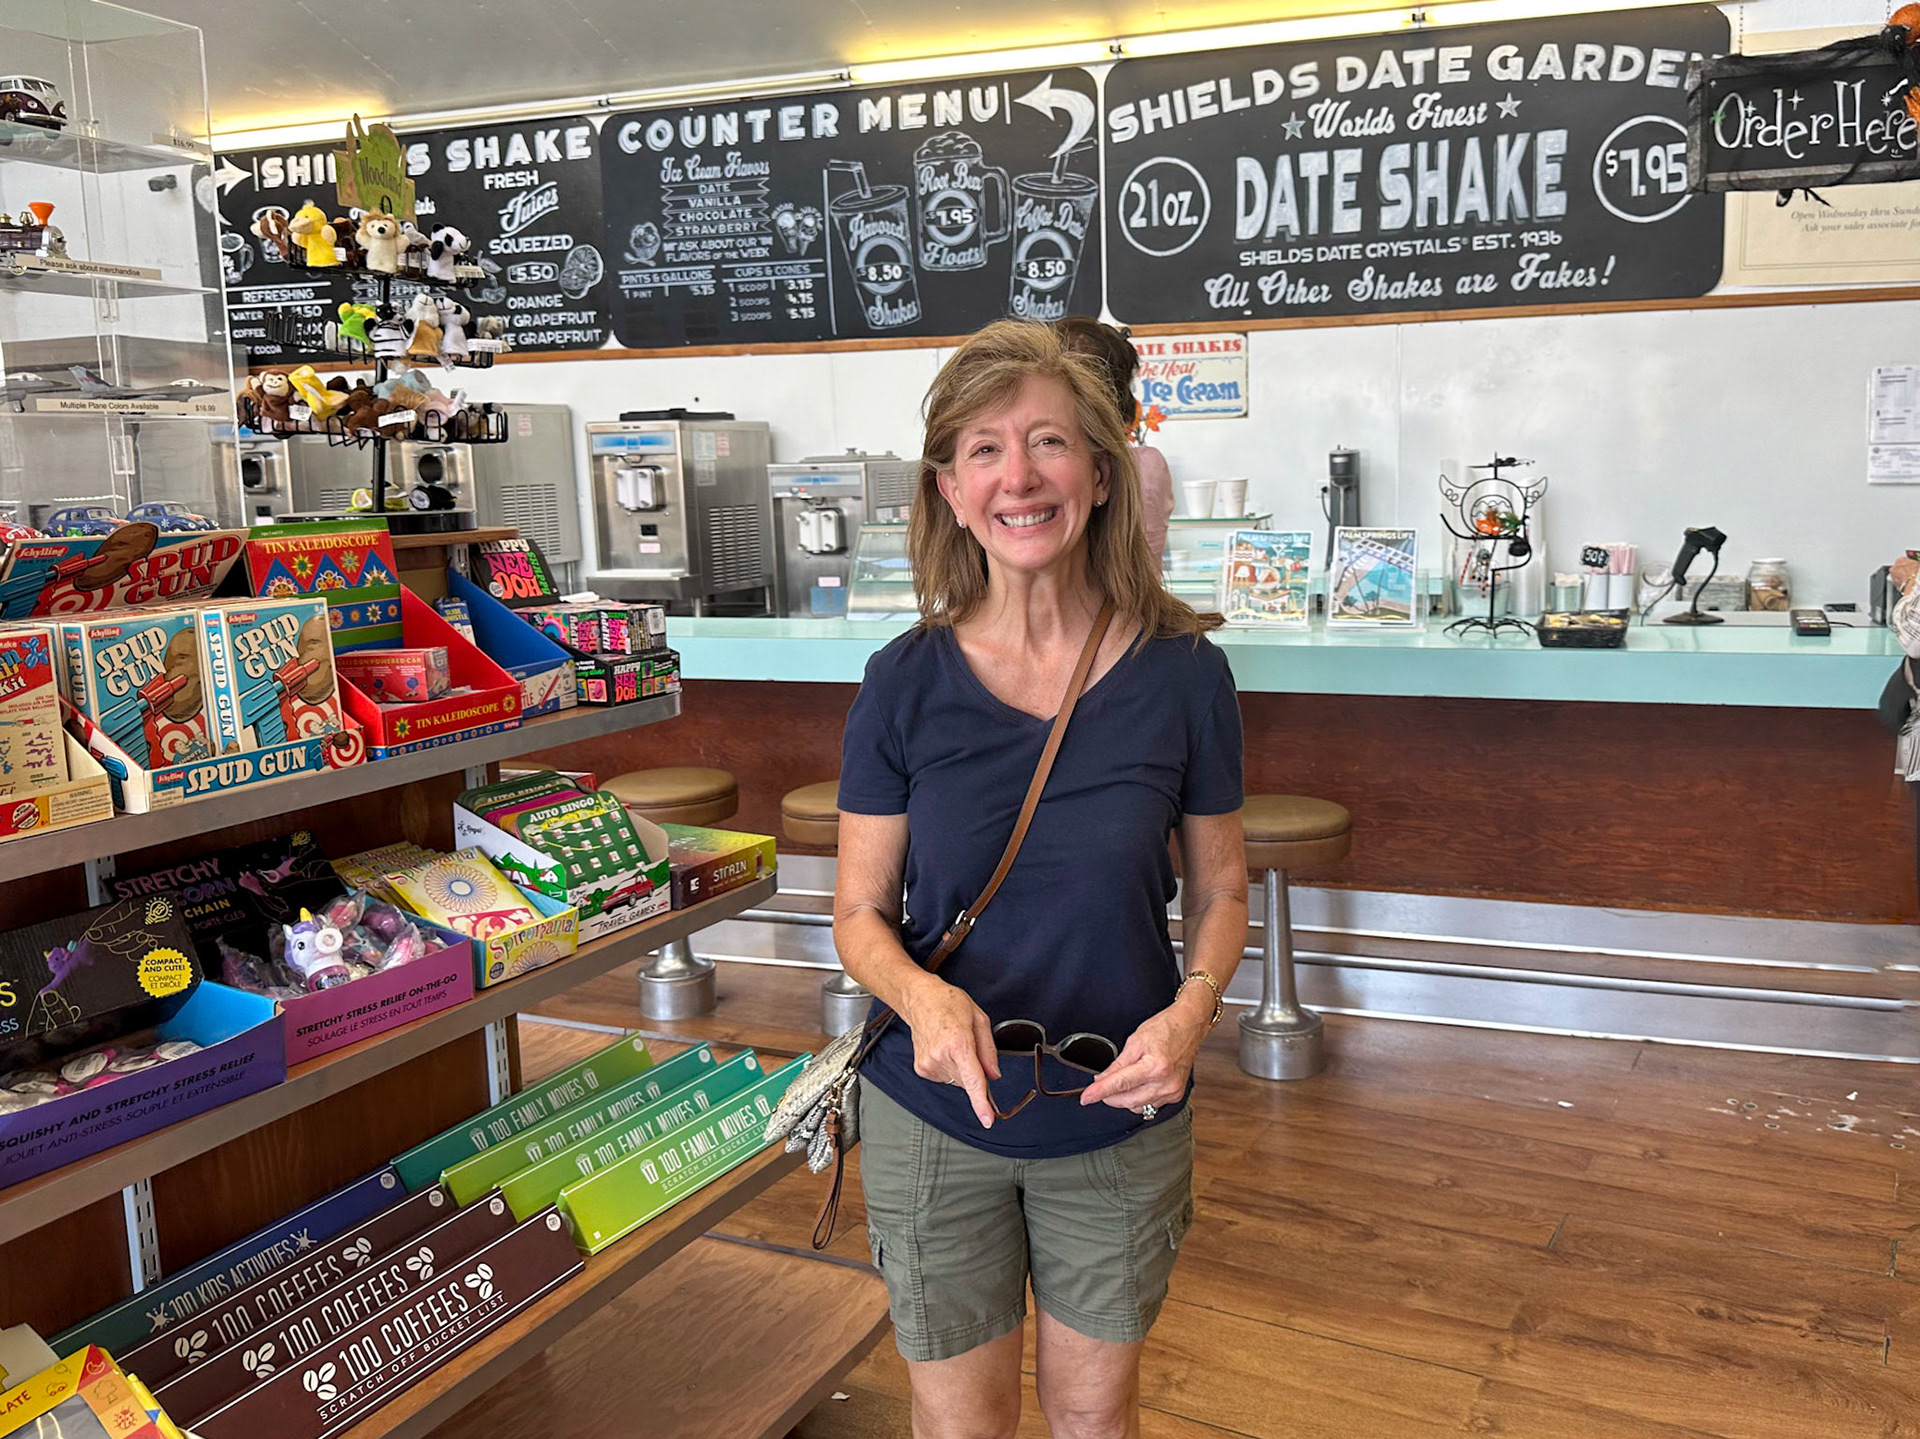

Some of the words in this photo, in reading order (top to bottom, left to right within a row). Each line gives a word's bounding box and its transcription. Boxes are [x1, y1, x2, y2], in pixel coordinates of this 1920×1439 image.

[1108, 61, 1321, 144] SHIELDS
[1336, 45, 1473, 93] DATE
[617, 103, 840, 154] COUNTER
[858, 86, 999, 133] MENU
[1307, 98, 1396, 139] Worlds
[1406, 91, 1488, 130] Finest
[1714, 89, 1834, 159] Order
[1833, 79, 1917, 154] Here
[446, 126, 592, 172] SHAKE
[483, 169, 539, 190] FRESH
[661, 157, 684, 182] Ice
[685, 154, 723, 181] Cream
[724, 151, 770, 178] Flavors
[919, 166, 951, 196] Root
[951, 161, 983, 191] Beer
[1605, 142, 1687, 196] $7.95
[699, 183, 731, 194] DATE
[1235, 148, 1363, 241] DATE
[1379, 128, 1569, 232] SHAKE
[501, 187, 559, 232] Juices
[688, 195, 742, 208] VANILLA
[675, 222, 759, 236] STRAWBERRY
[678, 208, 753, 223] CHOCOLATE
[1017, 198, 1053, 231] Coffee
[1054, 202, 1085, 240] Date
[488, 234, 574, 254] SQUEEZED
[678, 240, 700, 251] ASK
[700, 239, 735, 250] ABOUT
[736, 237, 757, 248] OUR
[848, 213, 907, 251] Flavored
[666, 251, 711, 262] FLAVORS
[724, 251, 739, 259] THE
[740, 247, 770, 258] WEEK
[923, 241, 982, 266] Floats
[1239, 247, 1314, 267] SHIELDS
[1316, 244, 1363, 263] DATE
[1472, 233, 1517, 251] EST.
[1519, 230, 1563, 247] 1936
[40, 258, 64, 269] Please
[65, 262, 78, 271] ask
[79, 263, 99, 272] about
[99, 265, 141, 276] merchandise
[621, 273, 651, 285] PINTS
[661, 270, 713, 282] GALLONS
[734, 266, 764, 278] CUPS
[775, 264, 811, 276] CONES
[1204, 272, 1250, 309] All
[1258, 269, 1333, 305] Other
[1347, 266, 1443, 302] Shakes
[1455, 272, 1498, 296] are
[1510, 252, 1616, 292] Fakes!
[242, 288, 315, 303] REFRESHING
[506, 294, 564, 309] ORANGE
[633, 289, 653, 299] PINT
[737, 283, 769, 293] SCOOP
[1013, 285, 1065, 318] Shakes
[231, 310, 264, 321] WATER
[738, 297, 771, 307] SCOOPS
[868, 295, 918, 325] Shakes
[512, 310, 597, 327] GRAPEFRUIT
[740, 311, 773, 321] SCOOPS
[232, 327, 267, 338] COFFEE
[518, 329, 602, 345] GRAPEFRUIT
[254, 345, 282, 355] COCOA
[1135, 343, 1165, 356] ATE
[1172, 341, 1243, 355] SHAKES
[1141, 378, 1173, 403] Ice
[1176, 375, 1241, 405] Cream
[60, 401, 87, 411] Multiple
[88, 402, 107, 410] Plane
[108, 402, 129, 410] Colors
[130, 402, 159, 411] Available
[19, 546, 65, 559] Schylling
[263, 541, 284, 554] TIN
[287, 534, 379, 552] KALEIDOSCOPE
[479, 539, 530, 553] HAPPY
[120, 534, 241, 588] SPUD
[483, 552, 534, 579] NEE
[124, 562, 221, 604] GUN
[493, 571, 543, 600] DOH
[95, 626, 168, 677] SPUD
[208, 631, 227, 689] SPUD
[105, 650, 167, 697] GUN
[217, 693, 236, 739] GUN
[415, 716, 432, 729] TIN
[433, 702, 500, 727] KALEIDOSCOPE
[186, 758, 254, 794] SPUD
[259, 746, 306, 776] GUN
[529, 807, 559, 823] AUTO
[559, 797, 595, 811] BINGO
[114, 857, 222, 900] STRETCHY
[184, 899, 231, 918] CHAIN
[598, 912, 627, 933] TRAVEL
[628, 904, 657, 923] GAMES
[143, 965, 163, 973] AND
[163, 963, 185, 972] CUTE!
[145, 957, 184, 967] COMPACT
[148, 974, 183, 983] COMPACT
[150, 981, 158, 989] ET
[296, 1013, 344, 1037] STRETCHY
[346, 1003, 378, 1020] STRESS
[380, 991, 407, 1008] RELIEF
[409, 973, 458, 998] ON-THE-GO
[307, 1026, 348, 1047] SOULAGE
[349, 1022, 359, 1033] LE
[360, 1013, 388, 1029] STRESS
[389, 1008, 401, 1019] EN
[402, 999, 423, 1014] TOUT
[424, 989, 448, 1006] TEMPS
[0, 1121, 63, 1150] SQUISHY
[68, 1109, 101, 1127] AND
[104, 1084, 171, 1115] STRETCHY
[173, 1068, 217, 1091] STRESS
[219, 1052, 256, 1074] RELIEF
[2, 1145, 46, 1167] JOUET
[47, 1114, 123, 1151] ANTI-STRESS
[126, 1100, 170, 1122] SOUPLE
[171, 1092, 184, 1107] ET
[186, 1070, 247, 1101] EXTENSIBLE
[658, 1147, 683, 1175] 100
[680, 1125, 719, 1162] FAMILY
[717, 1104, 757, 1140] MOVIES
[662, 1165, 700, 1191] SCRATCH
[702, 1154, 718, 1167] OFF
[720, 1135, 750, 1155] BUCKET
[338, 1335, 382, 1382] 100
[380, 1281, 469, 1357] COFFEES
[319, 1373, 385, 1420] SCRATCH
[391, 1352, 416, 1374] OFF
[423, 1315, 473, 1353] BUCKET
[479, 1293, 505, 1316] LIST
